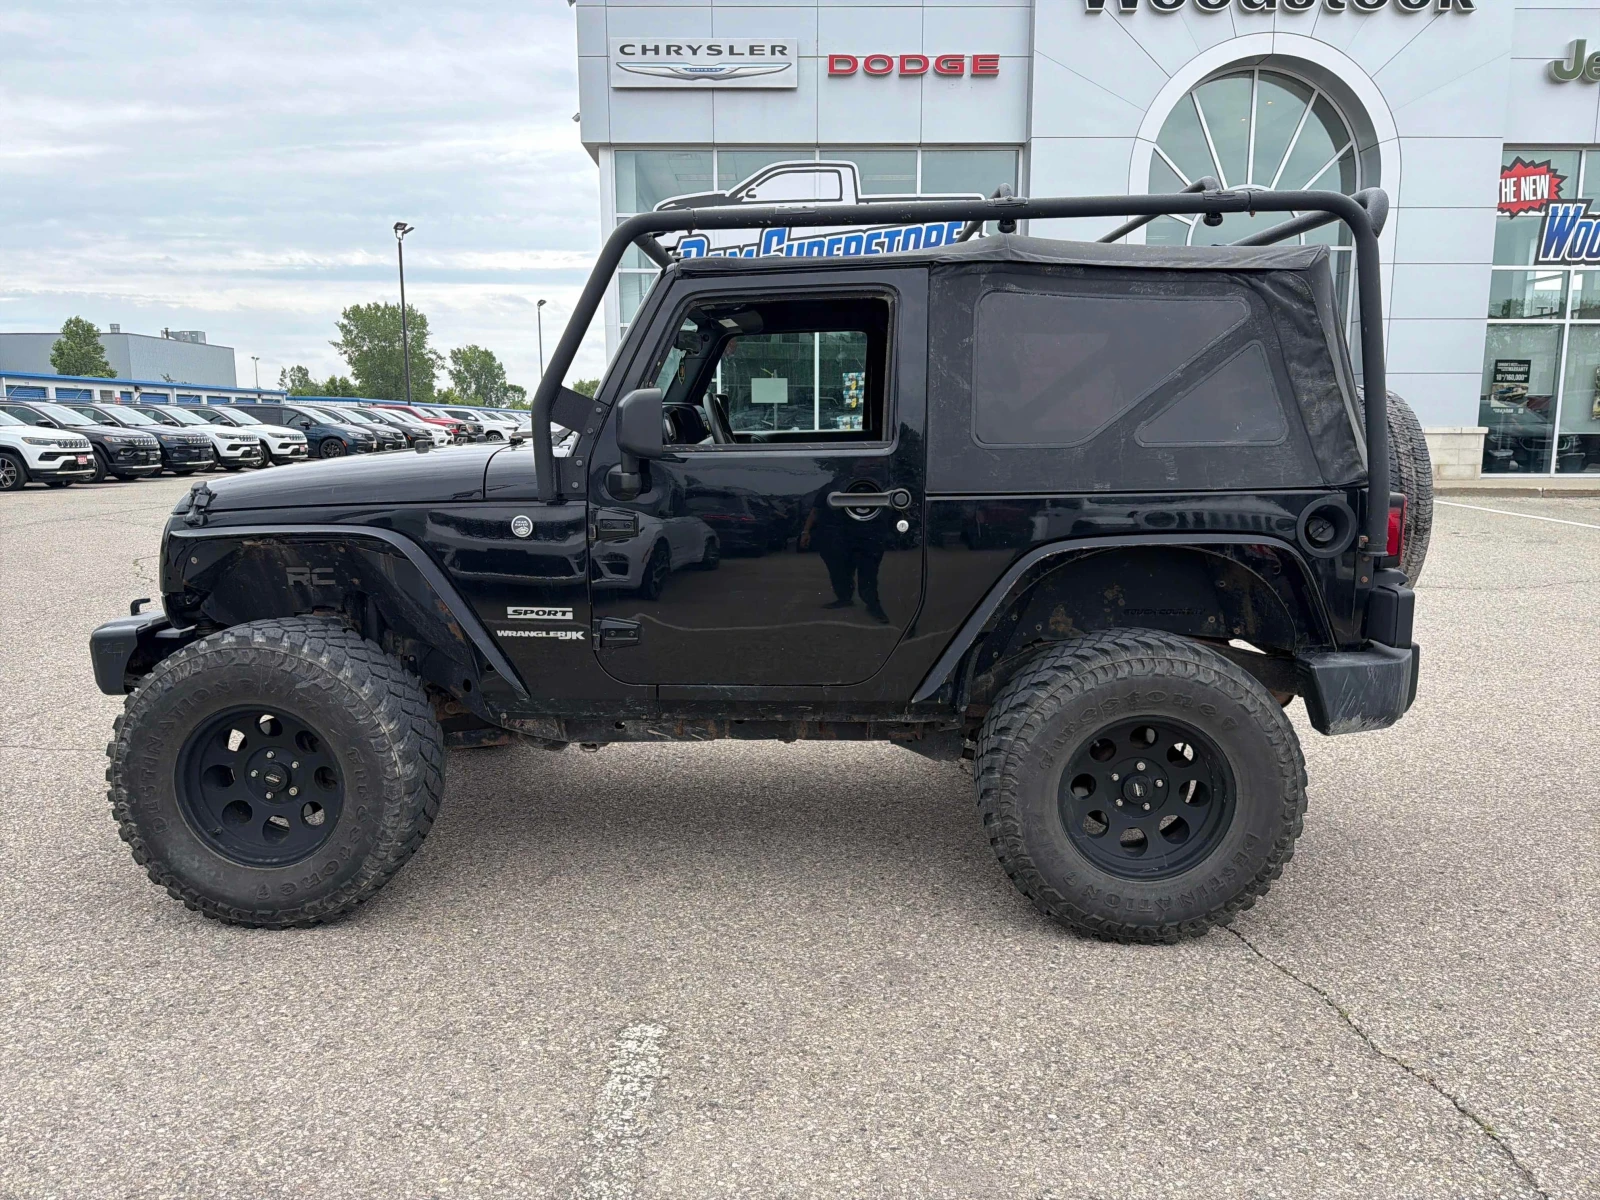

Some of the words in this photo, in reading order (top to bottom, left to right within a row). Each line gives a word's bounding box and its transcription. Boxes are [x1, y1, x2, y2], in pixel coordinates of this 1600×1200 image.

[618, 43, 789, 57] CHRYSLER
[827, 53, 1000, 76] DODGE
[1520, 174, 1550, 201] NEW
[285, 566, 336, 586] RC
[512, 609, 572, 617] SPORT
